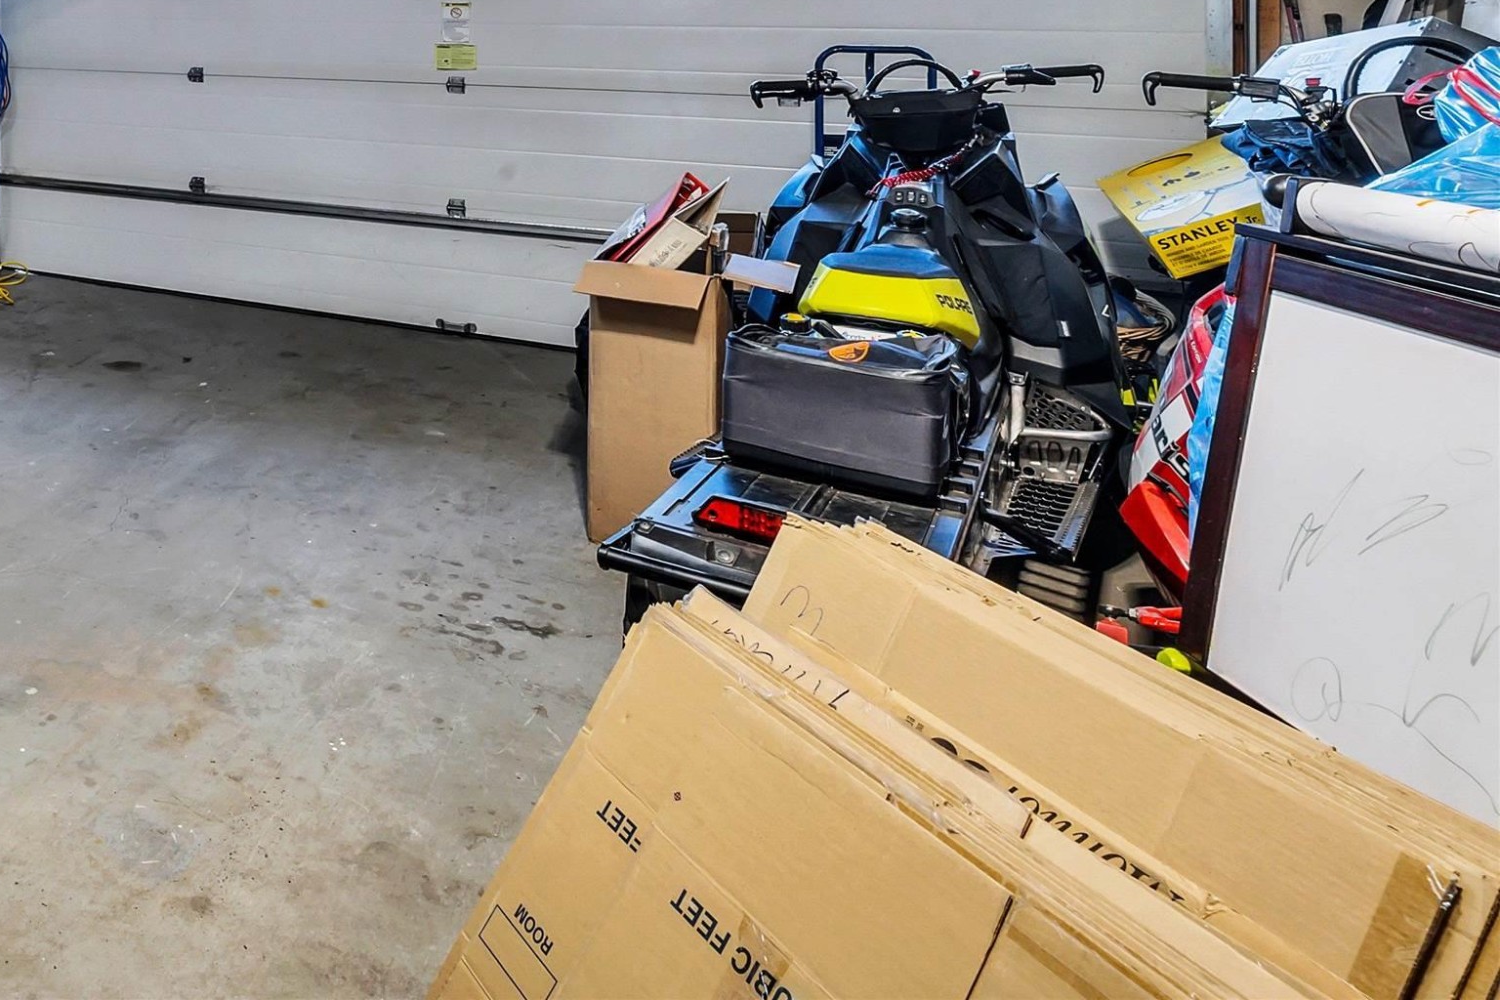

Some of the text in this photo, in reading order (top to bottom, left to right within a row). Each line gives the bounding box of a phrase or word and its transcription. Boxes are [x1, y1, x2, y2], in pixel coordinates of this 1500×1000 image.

[1158, 216, 1239, 250] STANLEY
[1151, 414, 1190, 486] aris
[513, 903, 553, 956] ROOM
[670, 888, 794, 1000] UBIC FEET
